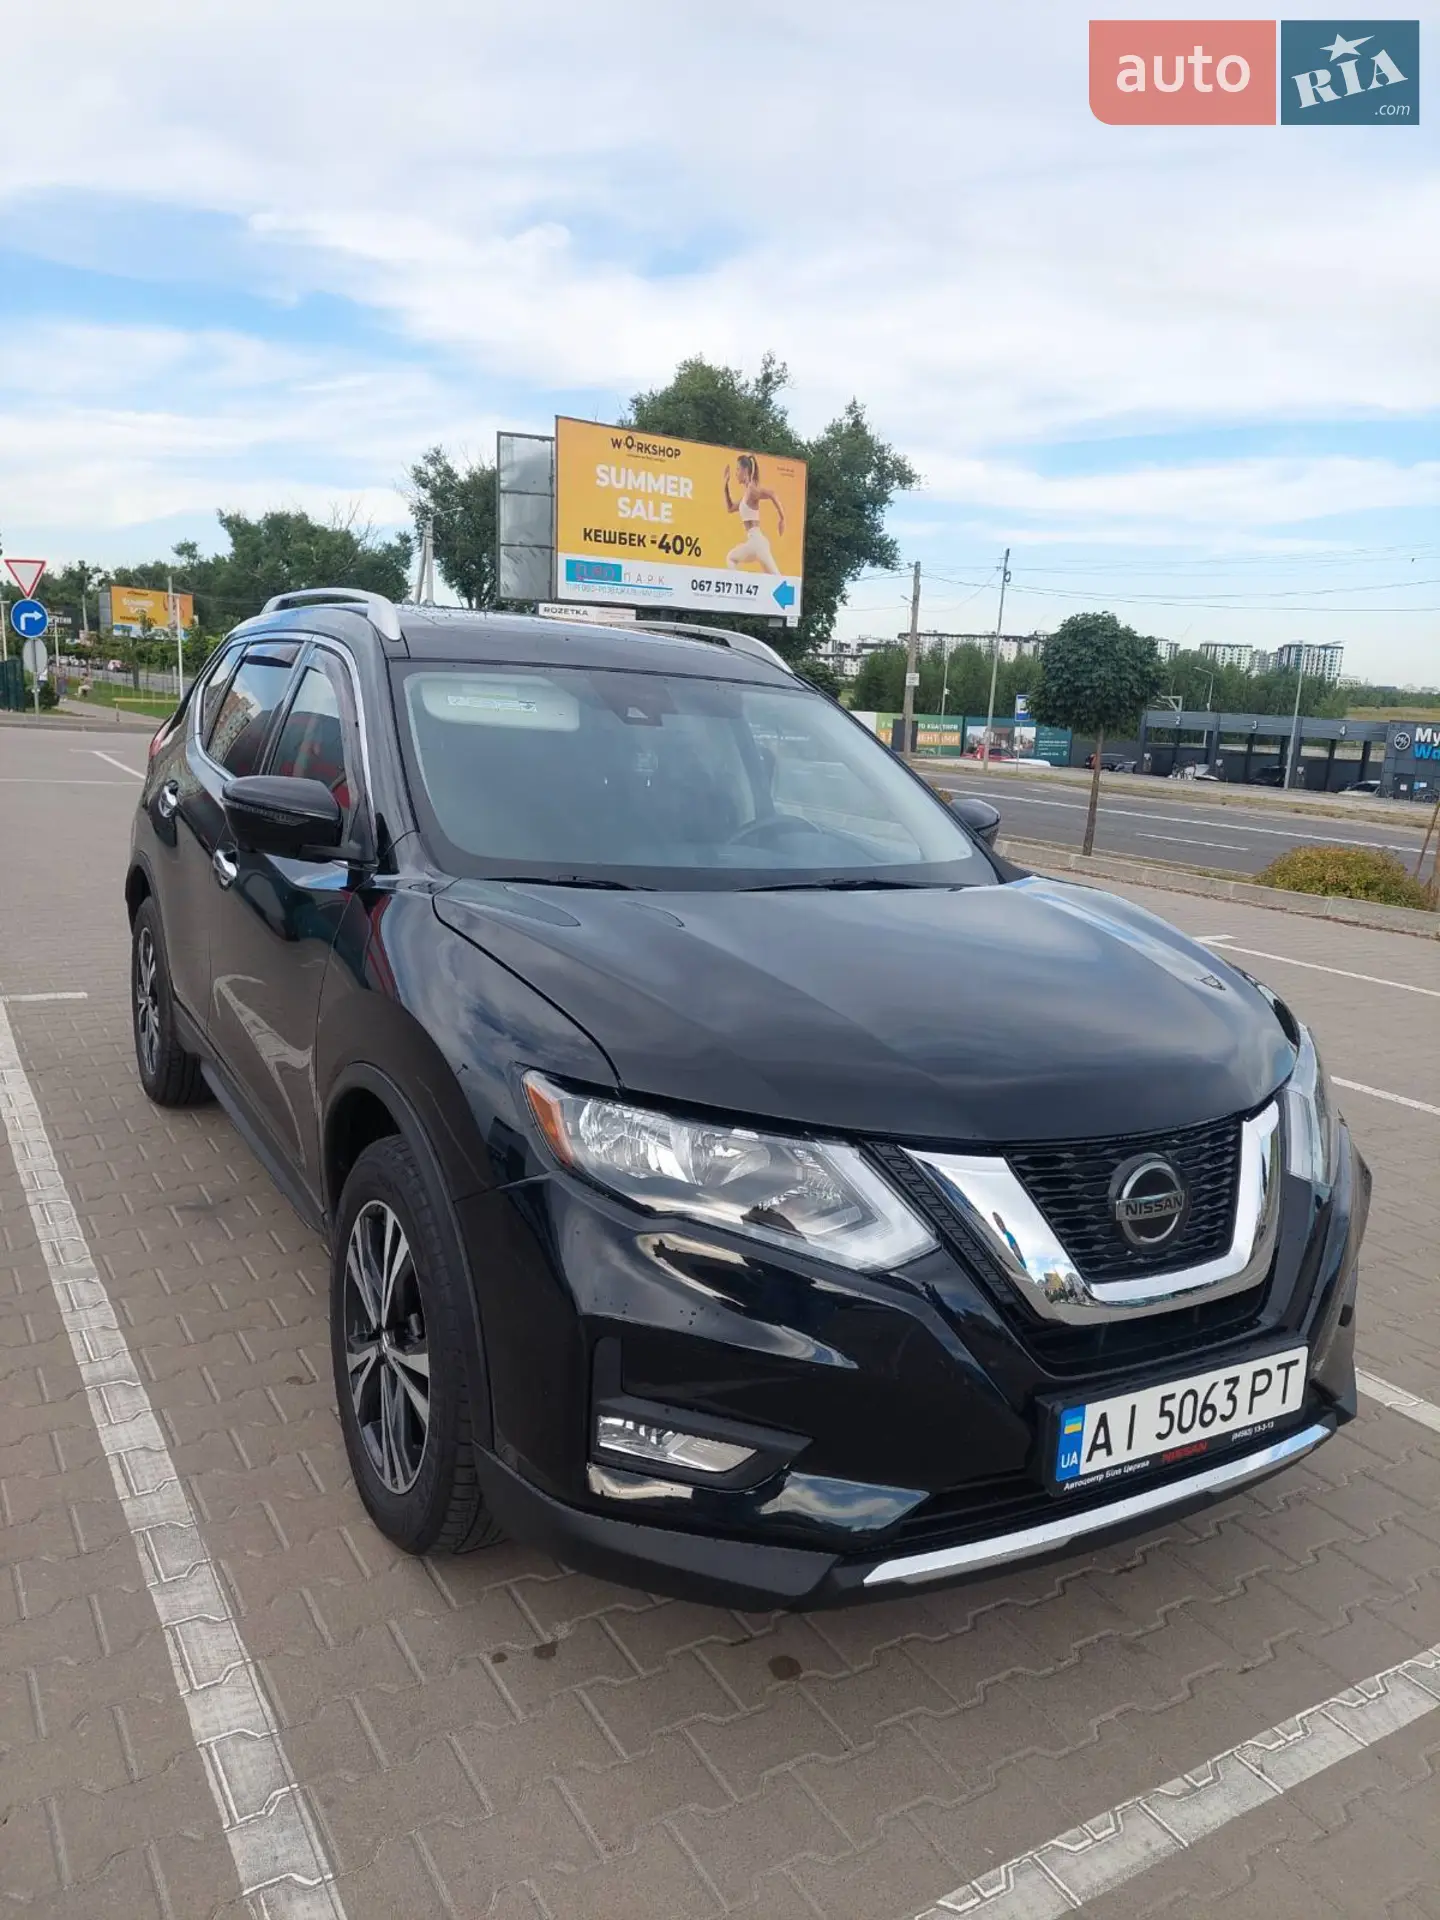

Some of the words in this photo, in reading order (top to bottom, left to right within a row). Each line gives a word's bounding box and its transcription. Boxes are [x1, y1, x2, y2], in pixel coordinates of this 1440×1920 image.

[611, 436, 681, 458] WORKSHOP
[595, 463, 693, 500] SUMMER
[617, 496, 674, 524] SALE
[583, 527, 647, 548] КЕШБЕК
[650, 533, 702, 557] -40%
[691, 579, 712, 592] 067
[715, 582, 732, 594] 517
[735, 583, 743, 595] 11
[746, 585, 759, 596] 47
[543, 606, 589, 616] ROZETKA
[1251, 720, 1258, 730] 3
[1339, 725, 1346, 736] 4
[1414, 727, 1440, 747] My
[1125, 1196, 1183, 1216] NISSAN
[1060, 1452, 1079, 1469] UA
[1085, 1404, 1137, 1464] AI
[1155, 1375, 1241, 1440] 5063
[1247, 1358, 1300, 1416] PT
